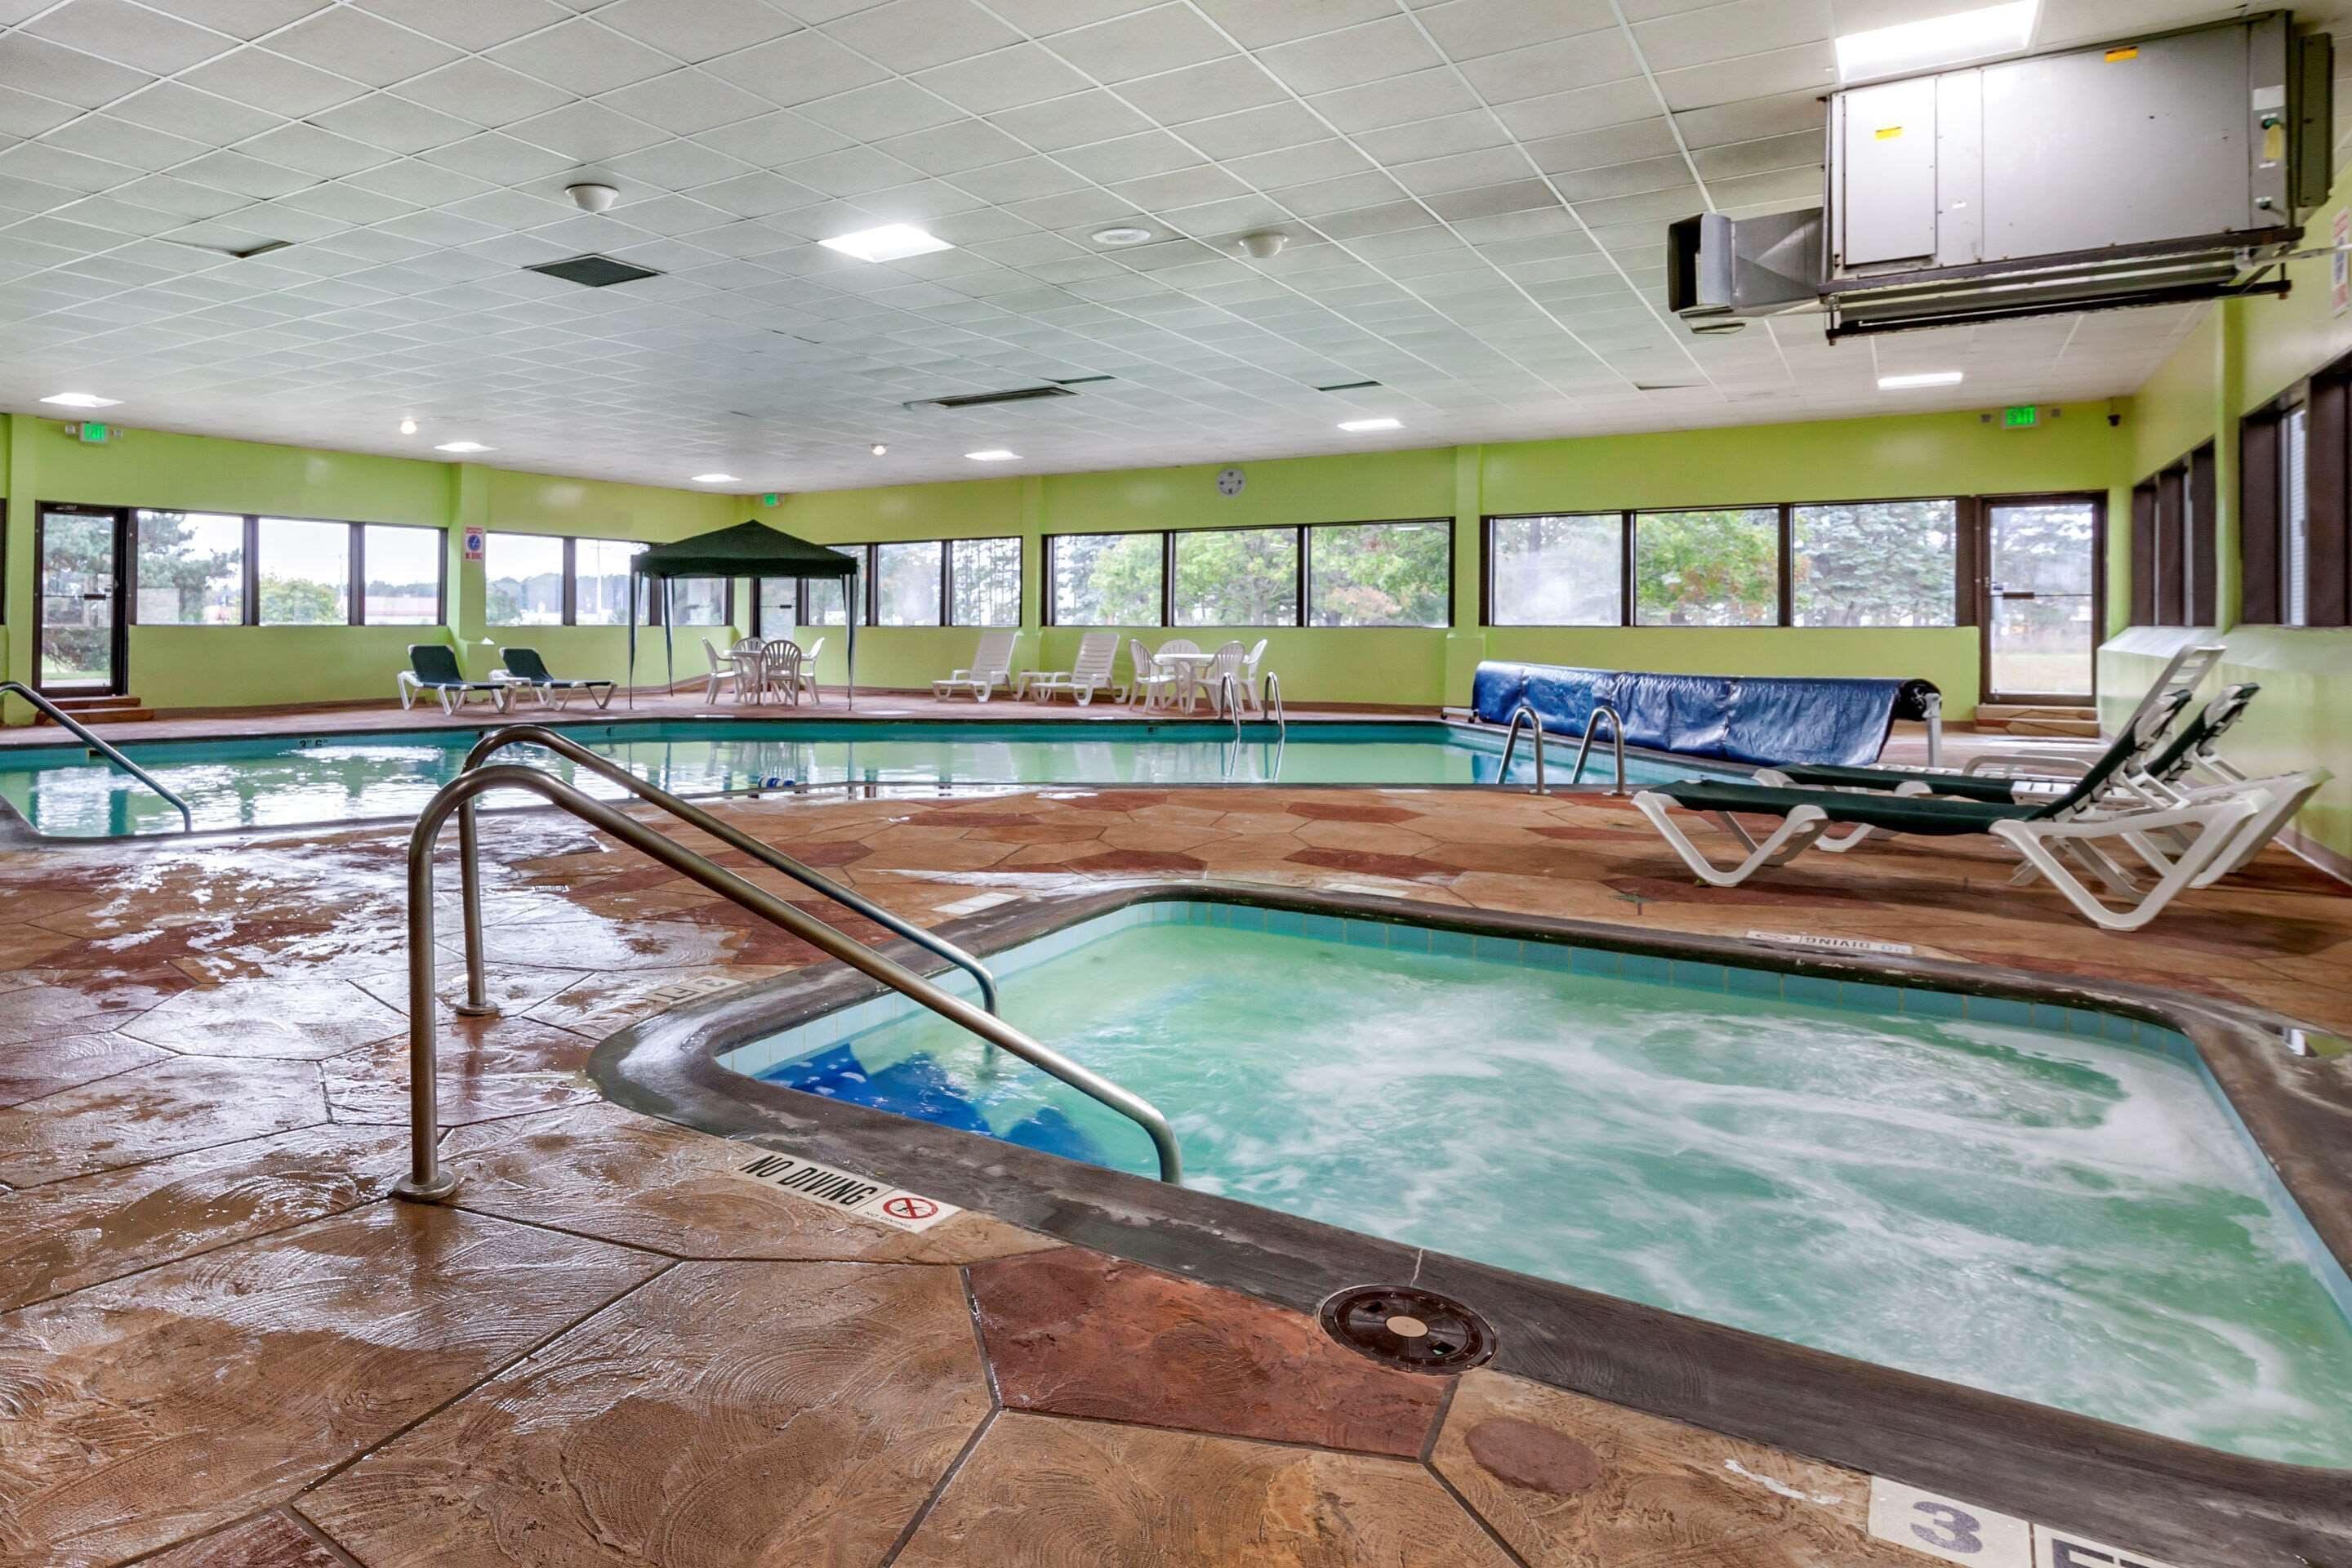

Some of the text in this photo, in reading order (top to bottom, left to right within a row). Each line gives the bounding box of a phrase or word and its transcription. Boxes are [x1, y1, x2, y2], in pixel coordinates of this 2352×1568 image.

[738, 1155, 878, 1205] NO DIVING
[1910, 1501, 1983, 1553] 3
